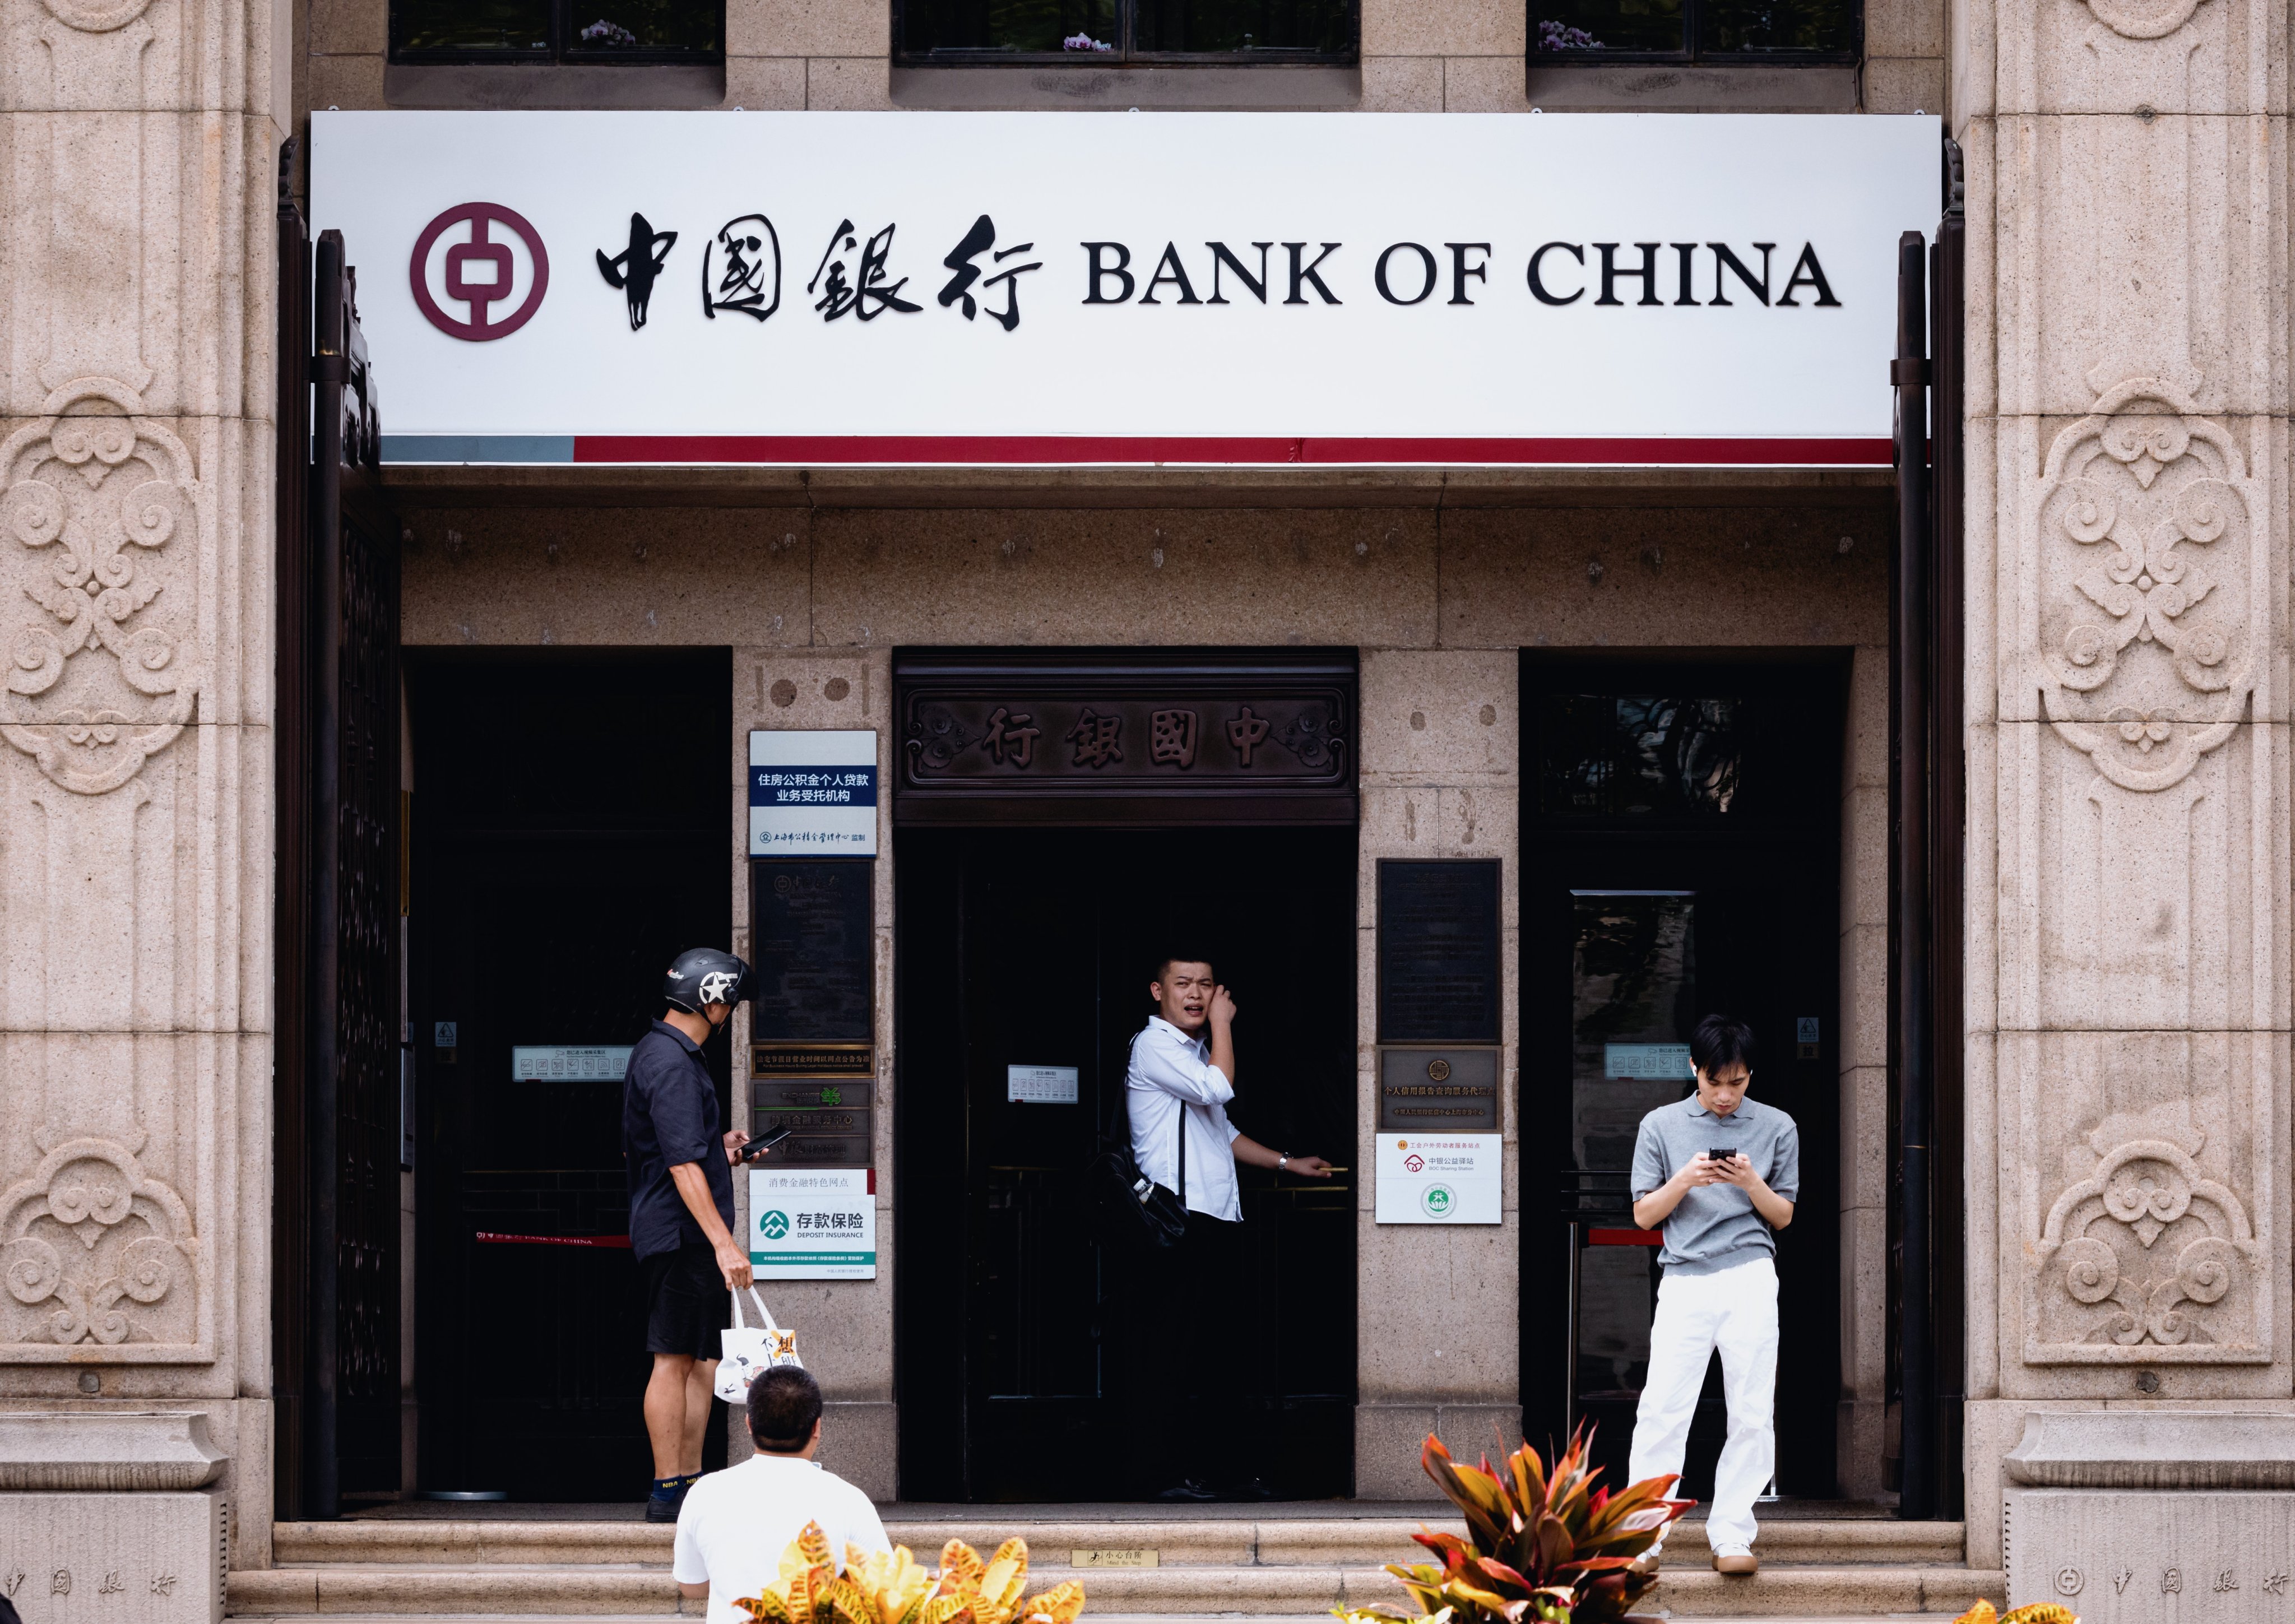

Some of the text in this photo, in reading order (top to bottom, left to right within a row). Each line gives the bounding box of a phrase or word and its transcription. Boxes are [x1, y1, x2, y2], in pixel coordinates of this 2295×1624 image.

[1080, 241, 1343, 305] BANK
[1374, 242, 1491, 305] OF
[1527, 242, 1842, 307] CHINA
[758, 773, 869, 787] 住房公积金个人贷款
[776, 789, 851, 802] 业务受托机构
[1384, 1086, 1496, 1096] 个人信用报告查询服务代理点
[1429, 1157, 1474, 1166] 中银公益驿站
[768, 1177, 849, 1187] 消费金融特色网点
[796, 1212, 864, 1229] 存款保险
[1105, 1551, 1142, 1560] 小心台阶
